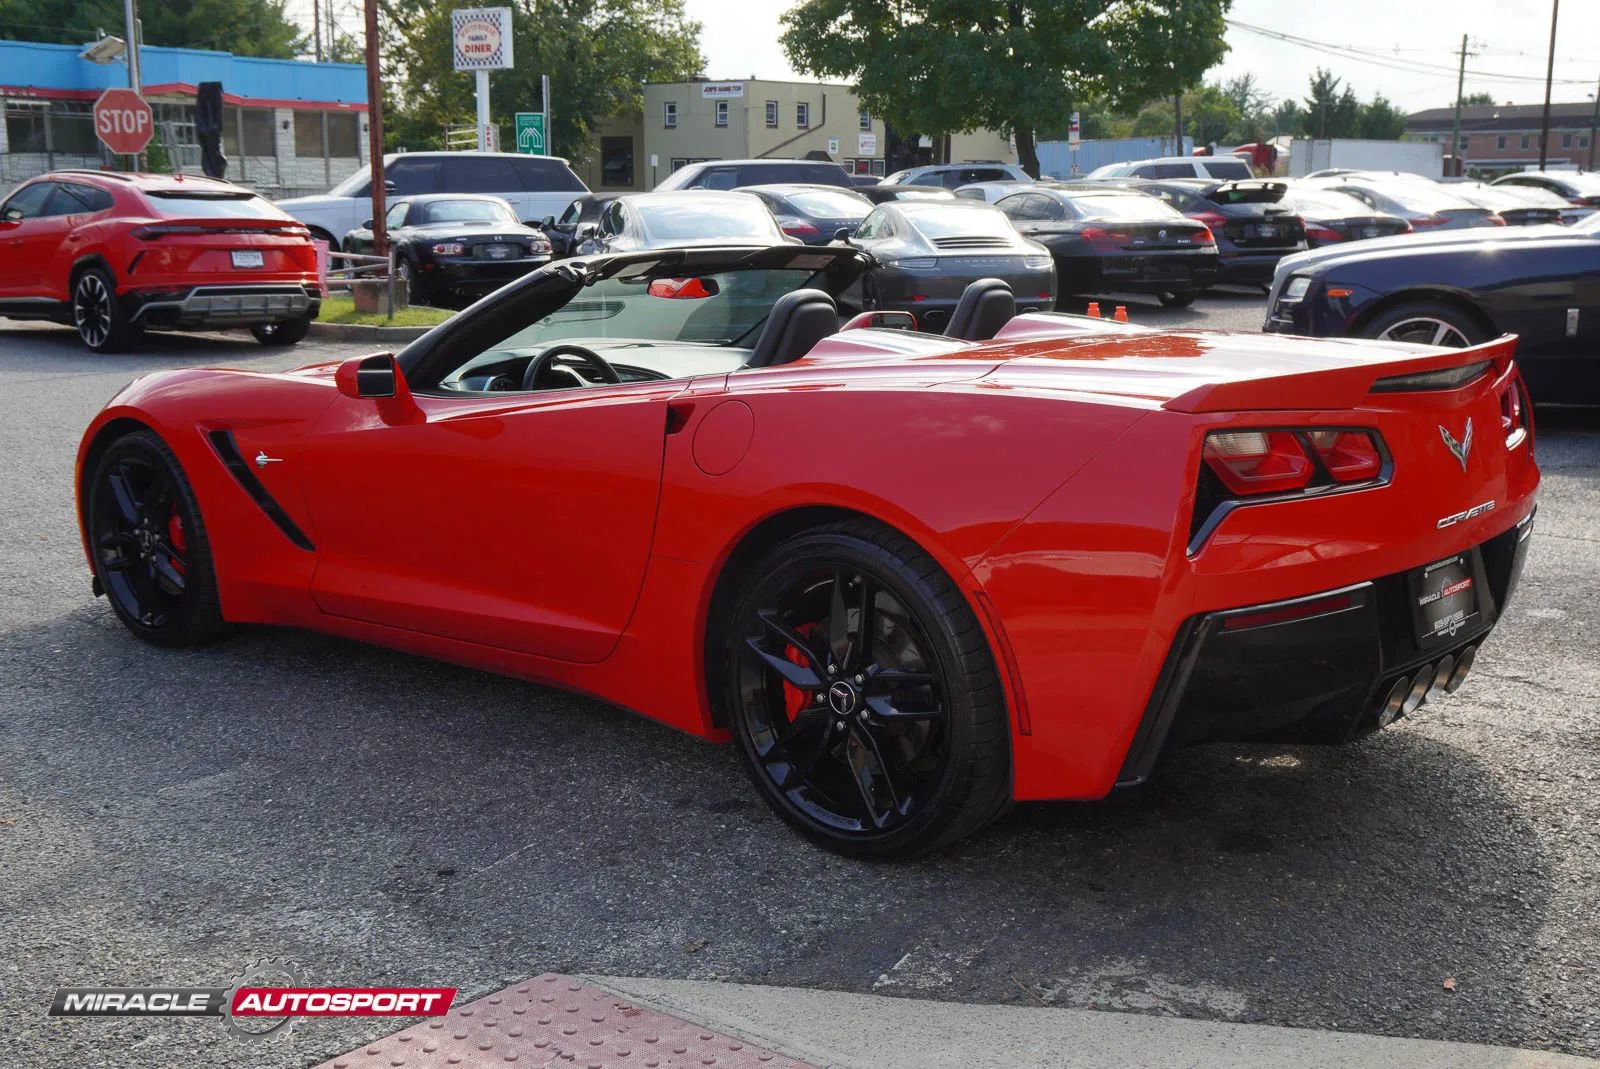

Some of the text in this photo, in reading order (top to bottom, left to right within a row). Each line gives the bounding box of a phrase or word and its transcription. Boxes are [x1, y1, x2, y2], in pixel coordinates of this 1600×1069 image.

[464, 43, 492, 53] DINER
[99, 109, 149, 134] STOP
[1437, 500, 1495, 528] CORVETTE
[1419, 578, 1471, 607] MIRACLE AUTOSPORT
